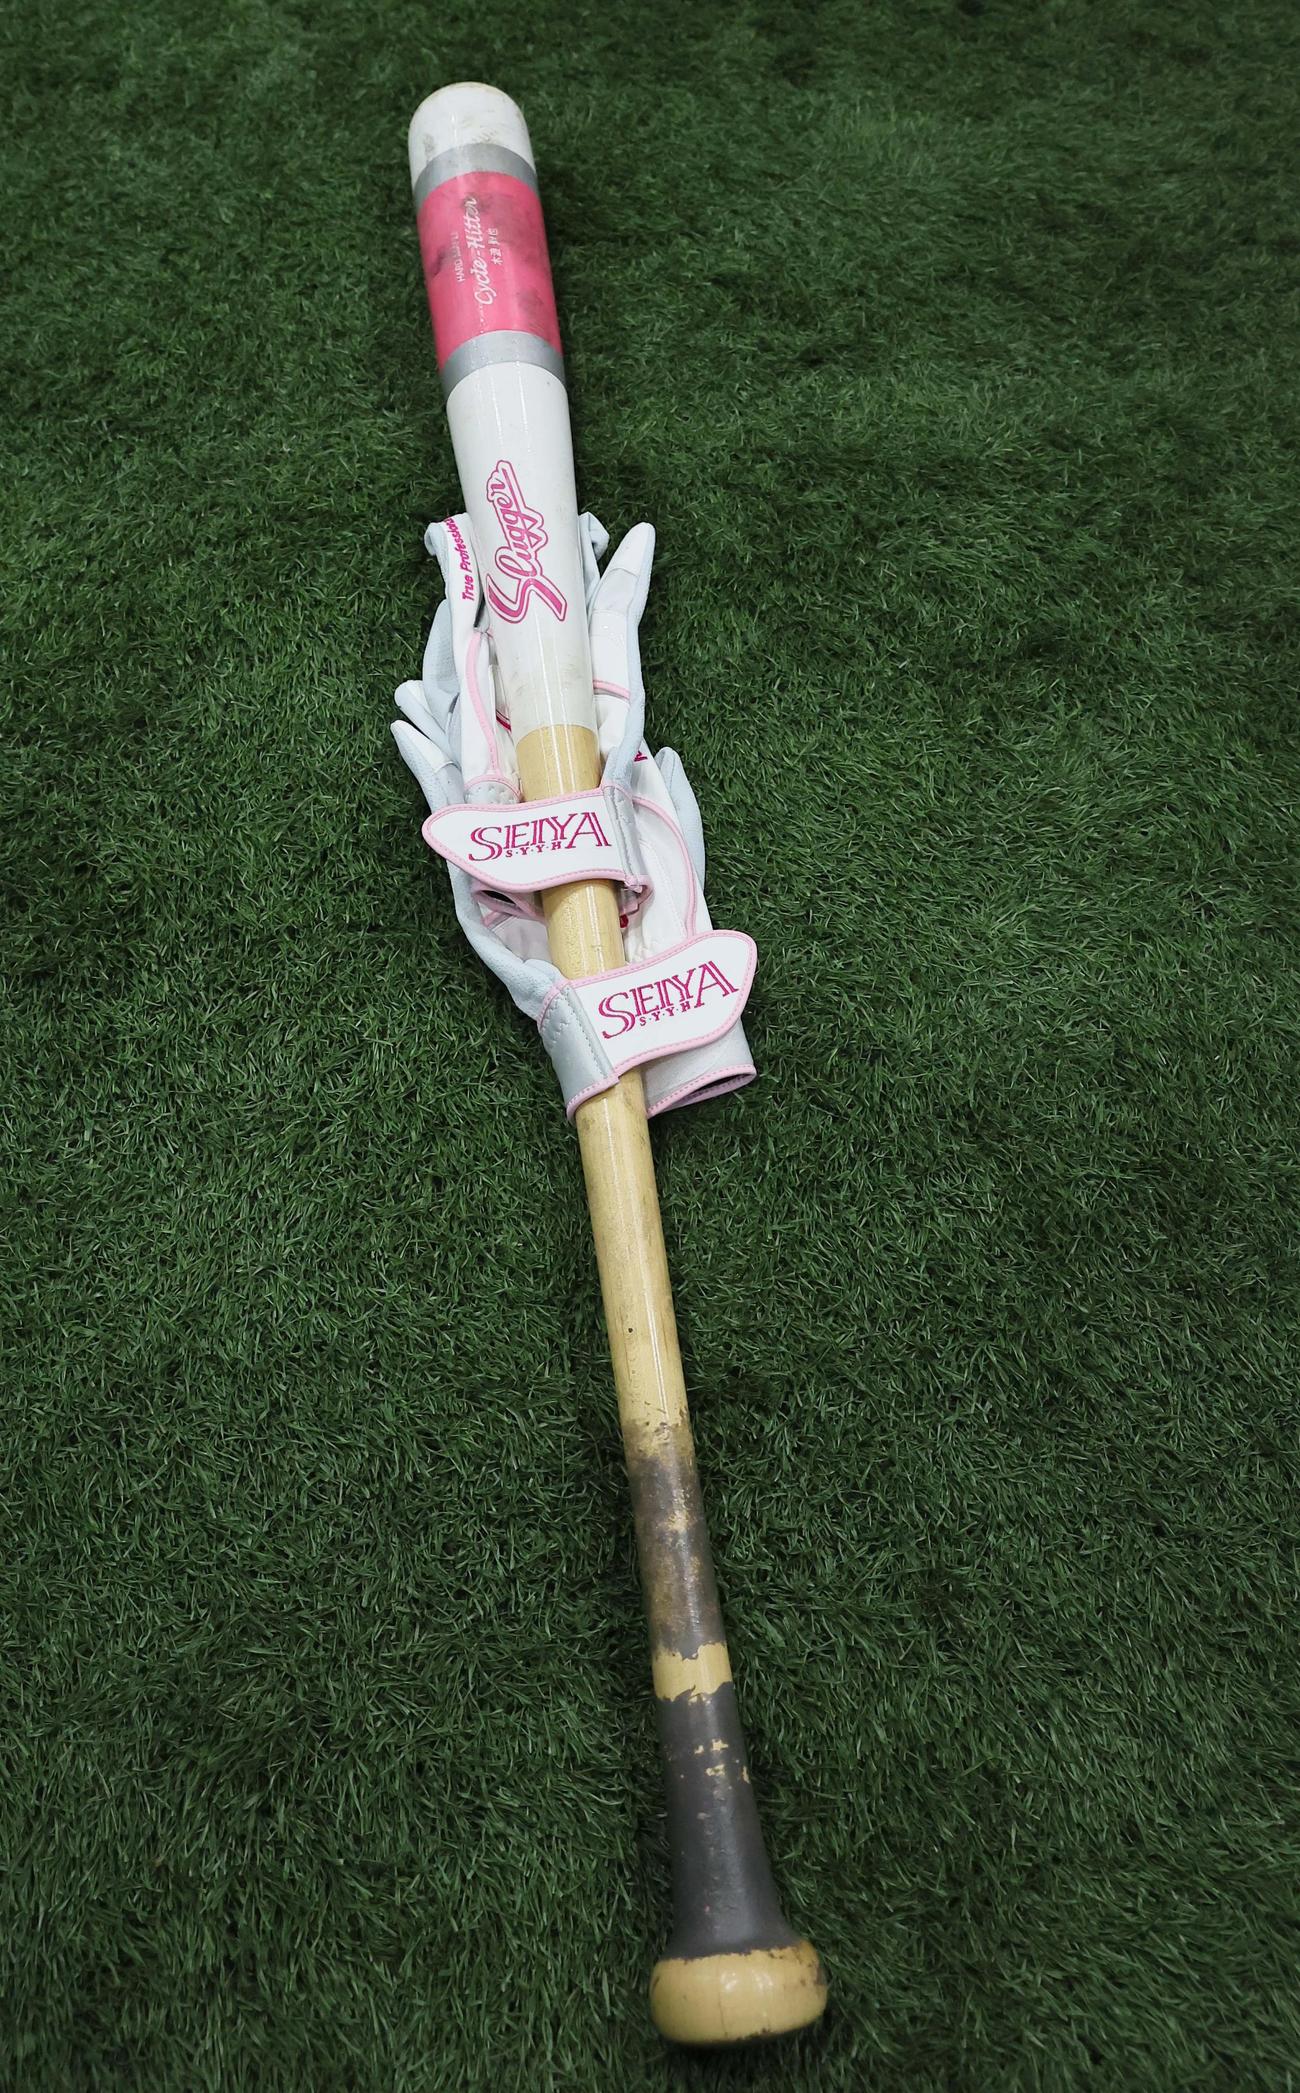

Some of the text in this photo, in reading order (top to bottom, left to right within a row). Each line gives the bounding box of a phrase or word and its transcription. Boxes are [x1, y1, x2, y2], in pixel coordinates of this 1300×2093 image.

[454, 259, 465, 282] HARD
[463, 198, 497, 305] Cycle-Hitter
[486, 460, 568, 624] Slugger
[462, 574, 475, 600] True
[468, 811, 612, 862] SEIYA
[598, 960, 740, 1039] SEIYA
